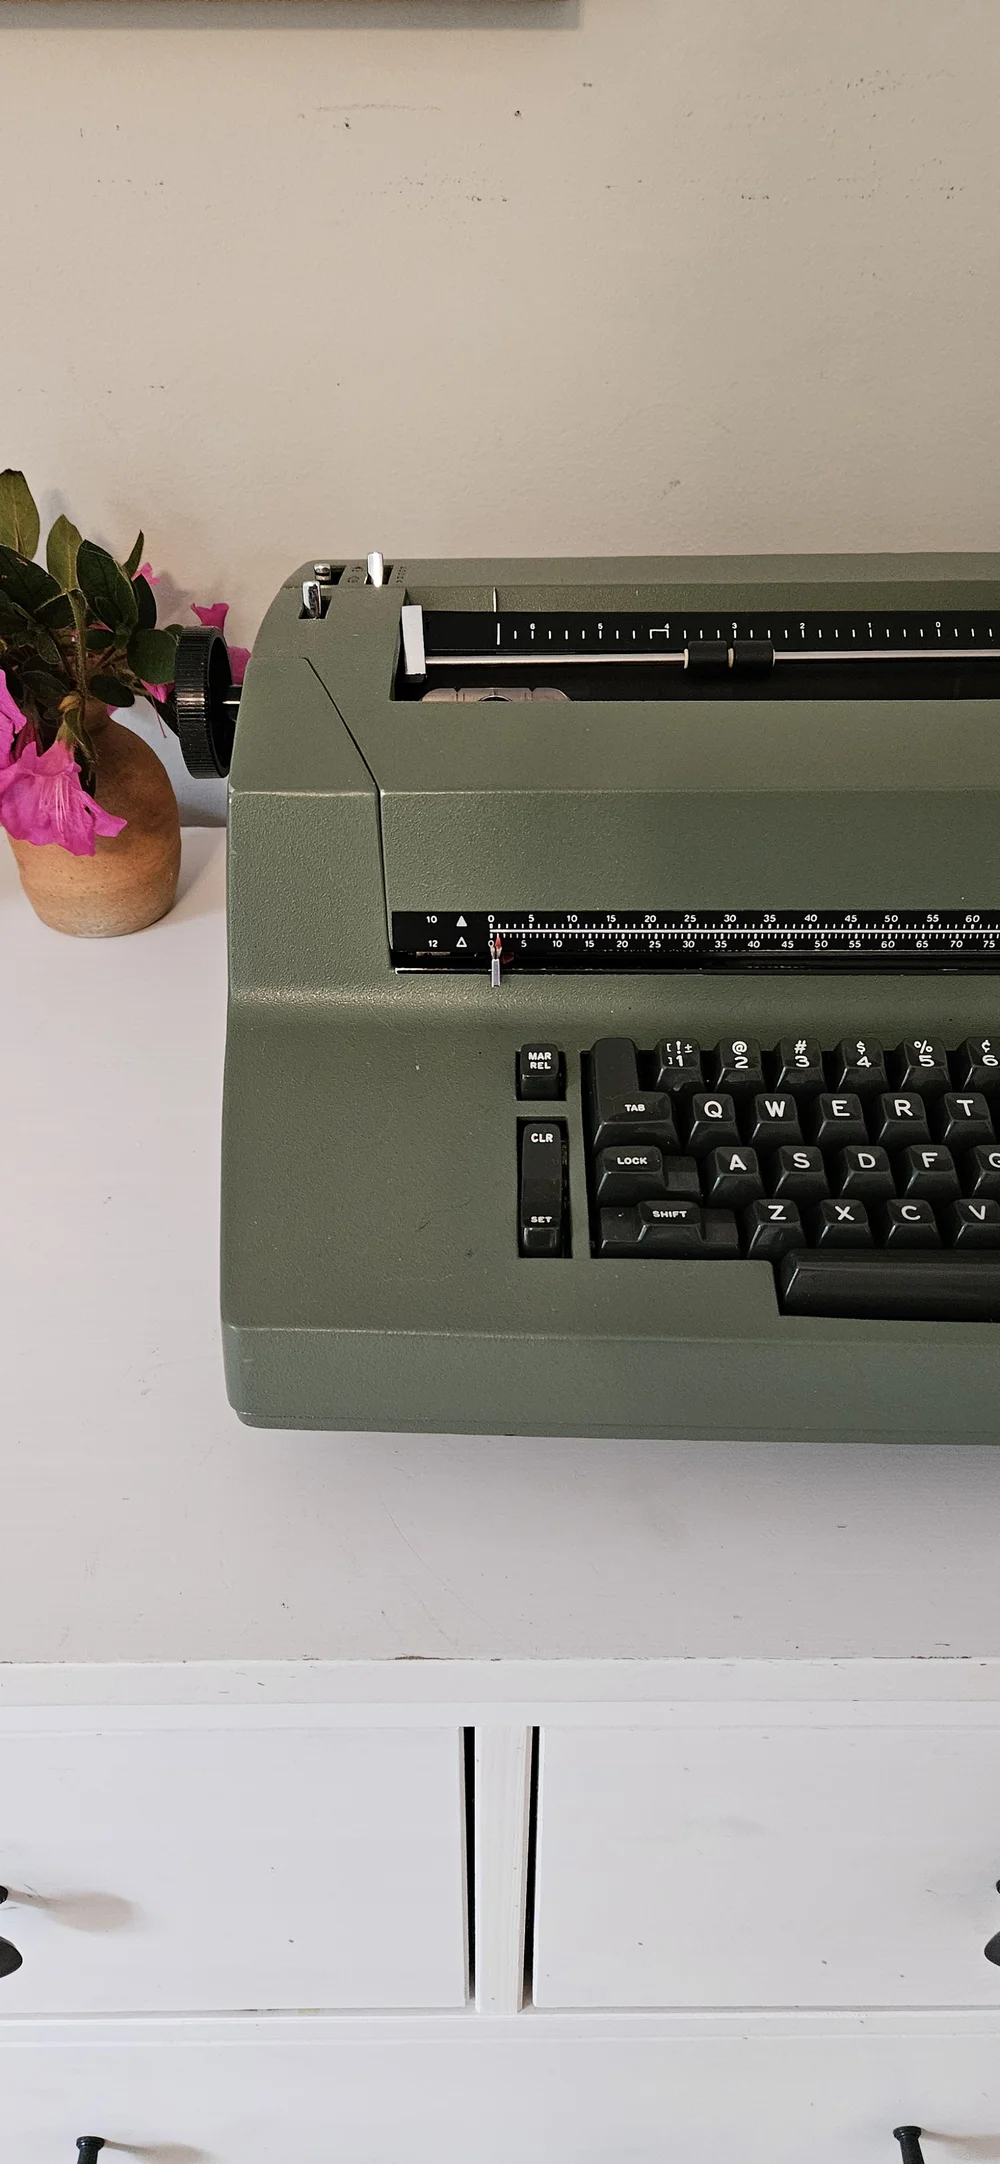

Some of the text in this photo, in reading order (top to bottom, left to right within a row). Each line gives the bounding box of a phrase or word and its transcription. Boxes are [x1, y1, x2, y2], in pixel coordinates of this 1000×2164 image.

[529, 622, 536, 630] 6
[425, 915, 438, 924] 10
[487, 913, 981, 924] 0 5 10 15 20 25 30 35 40 45 50 55 60
[428, 939, 439, 948] 12
[520, 940, 528, 948] 5
[552, 939, 563, 948] 10
[584, 939, 595, 948] 15
[616, 939, 629, 949] 20
[648, 940, 662, 949] 25
[682, 939, 696, 949] 30
[714, 939, 728, 949] 35
[747, 940, 761, 949] 40
[780, 941, 795, 949] 45
[814, 939, 829, 949] 50
[848, 939, 862, 949] 55
[880, 940, 896, 949] 60
[915, 939, 929, 949] 65
[950, 939, 964, 949] 70
[983, 939, 996, 949] 75
[675, 1040, 682, 1054] !
[731, 1040, 748, 1055] @
[793, 1039, 808, 1054] #
[855, 1040, 867, 1055] $
[913, 1039, 934, 1054] %
[980, 1039, 991, 1053] ¢
[527, 1051, 552, 1061] MAR
[675, 1054, 684, 1067] 1
[734, 1056, 749, 1069] 2
[794, 1056, 810, 1068] 3
[856, 1056, 872, 1068] 4
[918, 1055, 935, 1068] 5
[981, 1054, 999, 1067] 6
[529, 1061, 552, 1070] REL
[624, 1103, 646, 1113] TAB
[703, 1100, 723, 1119] Q
[764, 1100, 786, 1118] W
[831, 1099, 851, 1117] E
[893, 1099, 914, 1117] R
[955, 1099, 974, 1117] T
[530, 1132, 554, 1143] CLR
[616, 1156, 648, 1165] LOCK
[729, 1153, 748, 1171] A
[792, 1152, 811, 1169] S
[857, 1152, 876, 1169] D
[921, 1151, 939, 1169] F
[530, 1215, 553, 1224] SET
[652, 1210, 688, 1218] SHIFT
[767, 1204, 787, 1221] Z
[834, 1205, 855, 1221] X
[900, 1204, 921, 1221] C
[968, 1204, 987, 1221] V
